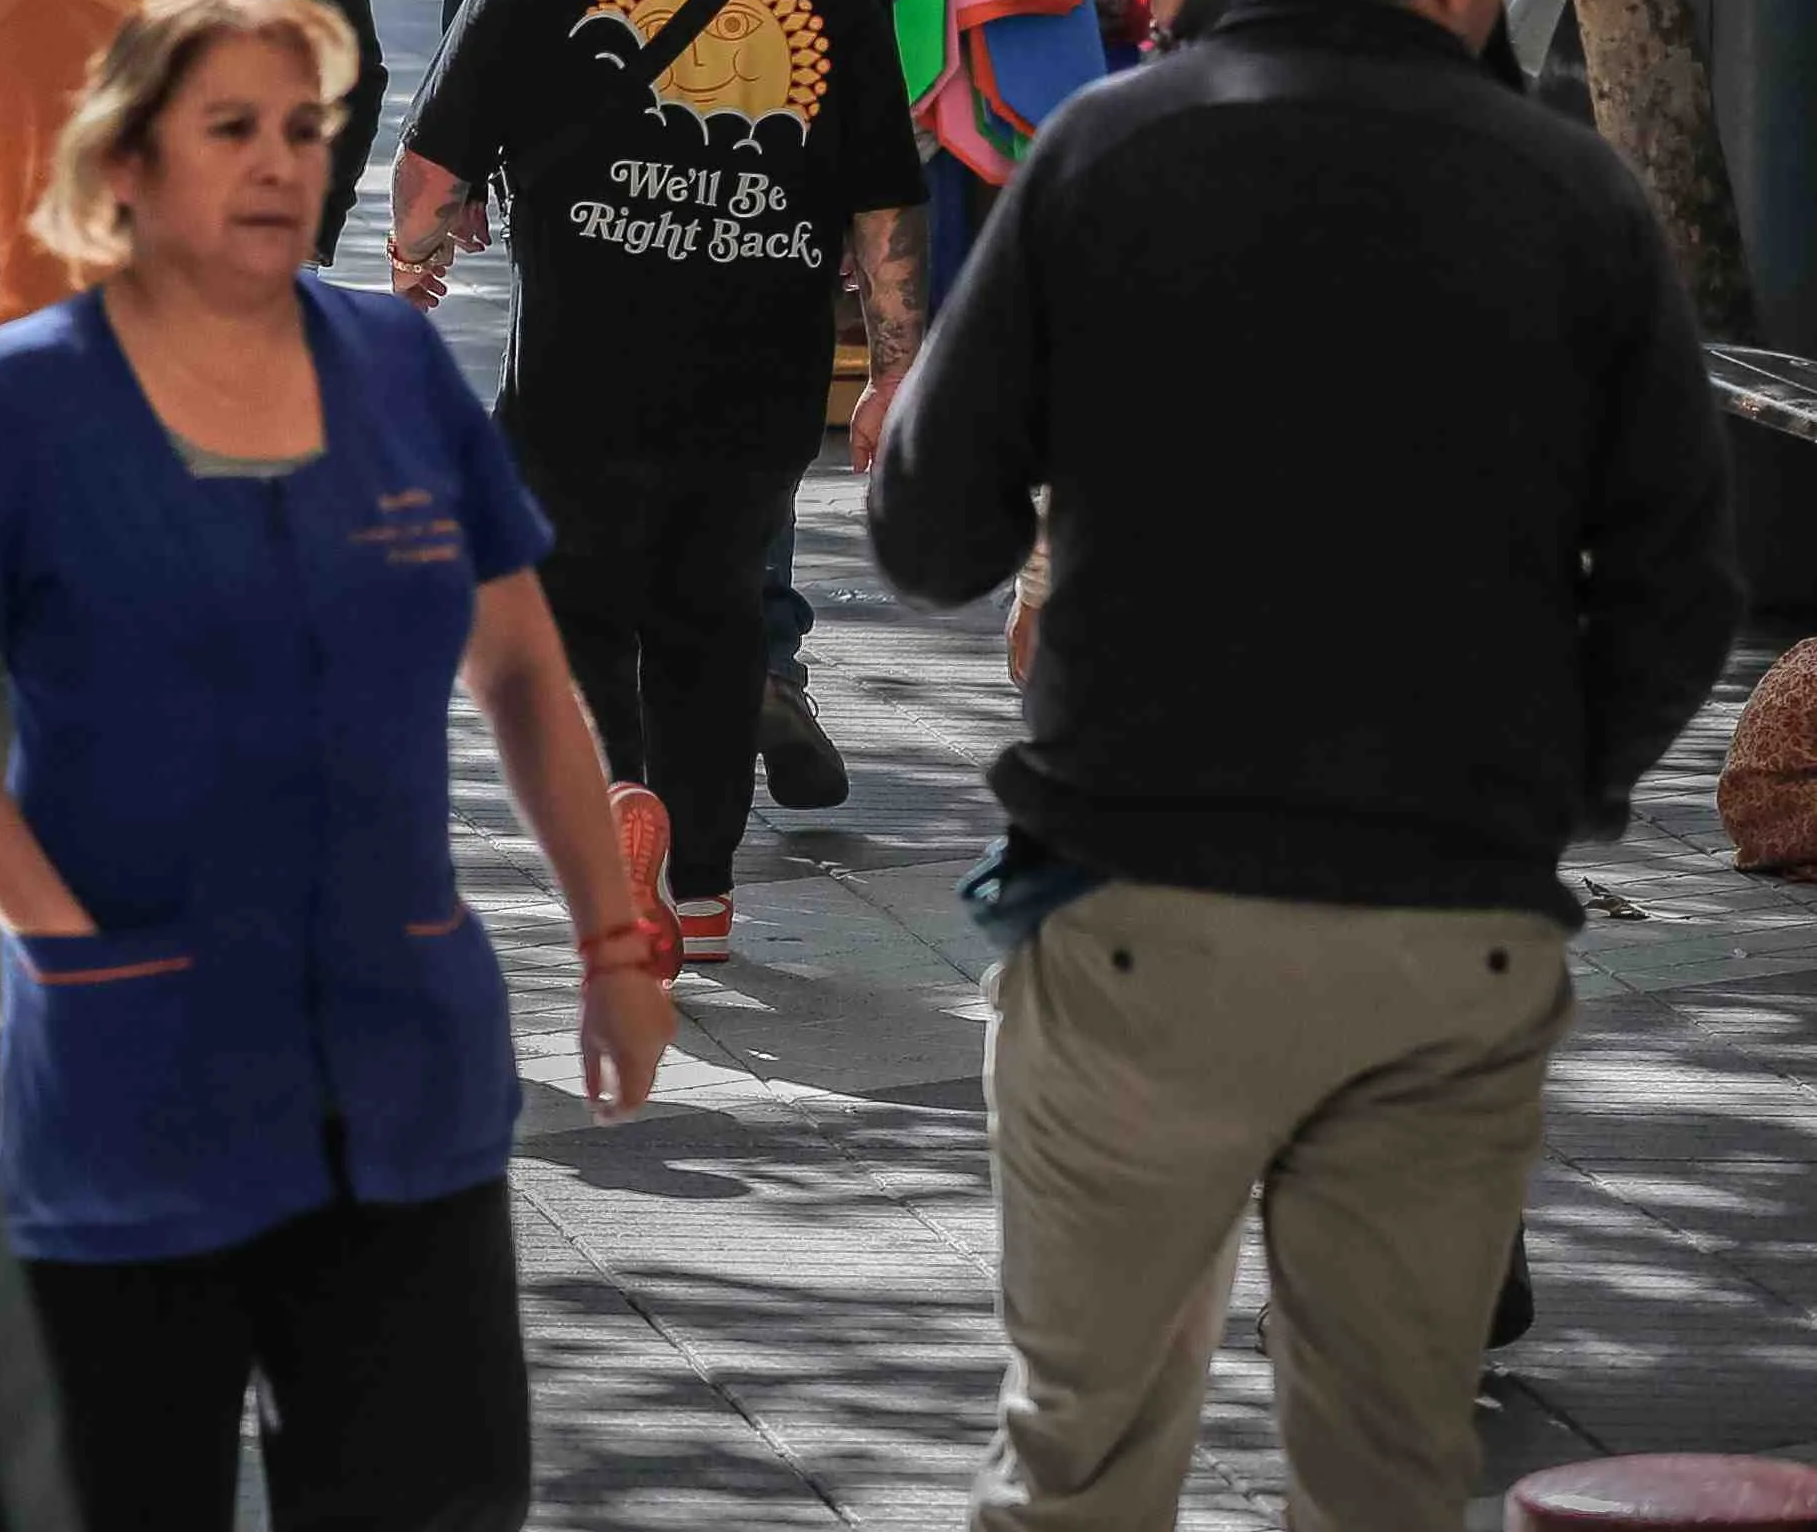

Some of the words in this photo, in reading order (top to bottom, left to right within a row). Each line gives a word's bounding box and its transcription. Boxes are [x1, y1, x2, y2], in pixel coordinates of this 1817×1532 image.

[610, 159, 722, 207] We'll
[728, 171, 787, 218] Be
[570, 201, 702, 260] Right
[708, 218, 822, 268] Back
